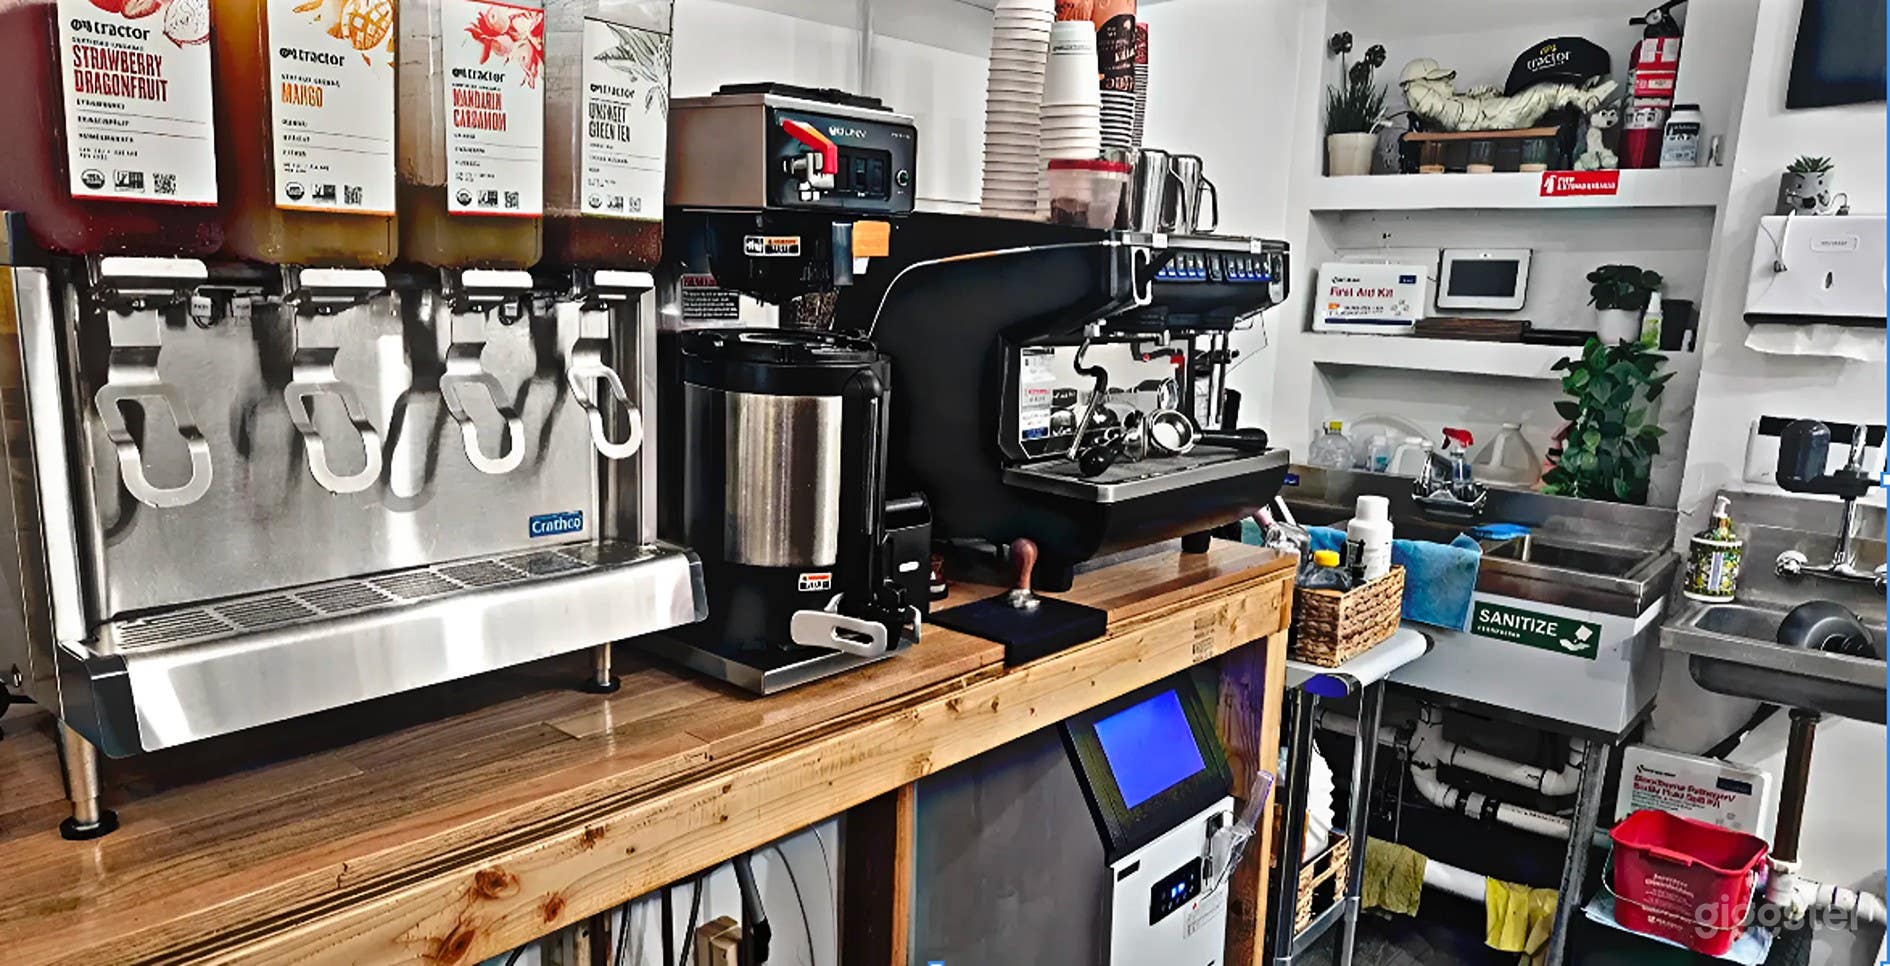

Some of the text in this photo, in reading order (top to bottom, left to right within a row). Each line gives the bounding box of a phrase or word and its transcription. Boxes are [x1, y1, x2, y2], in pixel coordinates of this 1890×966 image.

[95, 20, 150, 40] tractor
[72, 44, 162, 78] STRAWBERRY
[74, 69, 168, 102] DRAGONFRUIT
[282, 82, 324, 108] MANGO
[453, 88, 502, 111] MANDARIN
[1330, 286, 1394, 298] First Aid Kit
[532, 516, 581, 534] Crathco
[1479, 608, 1559, 637] SANITIZE
